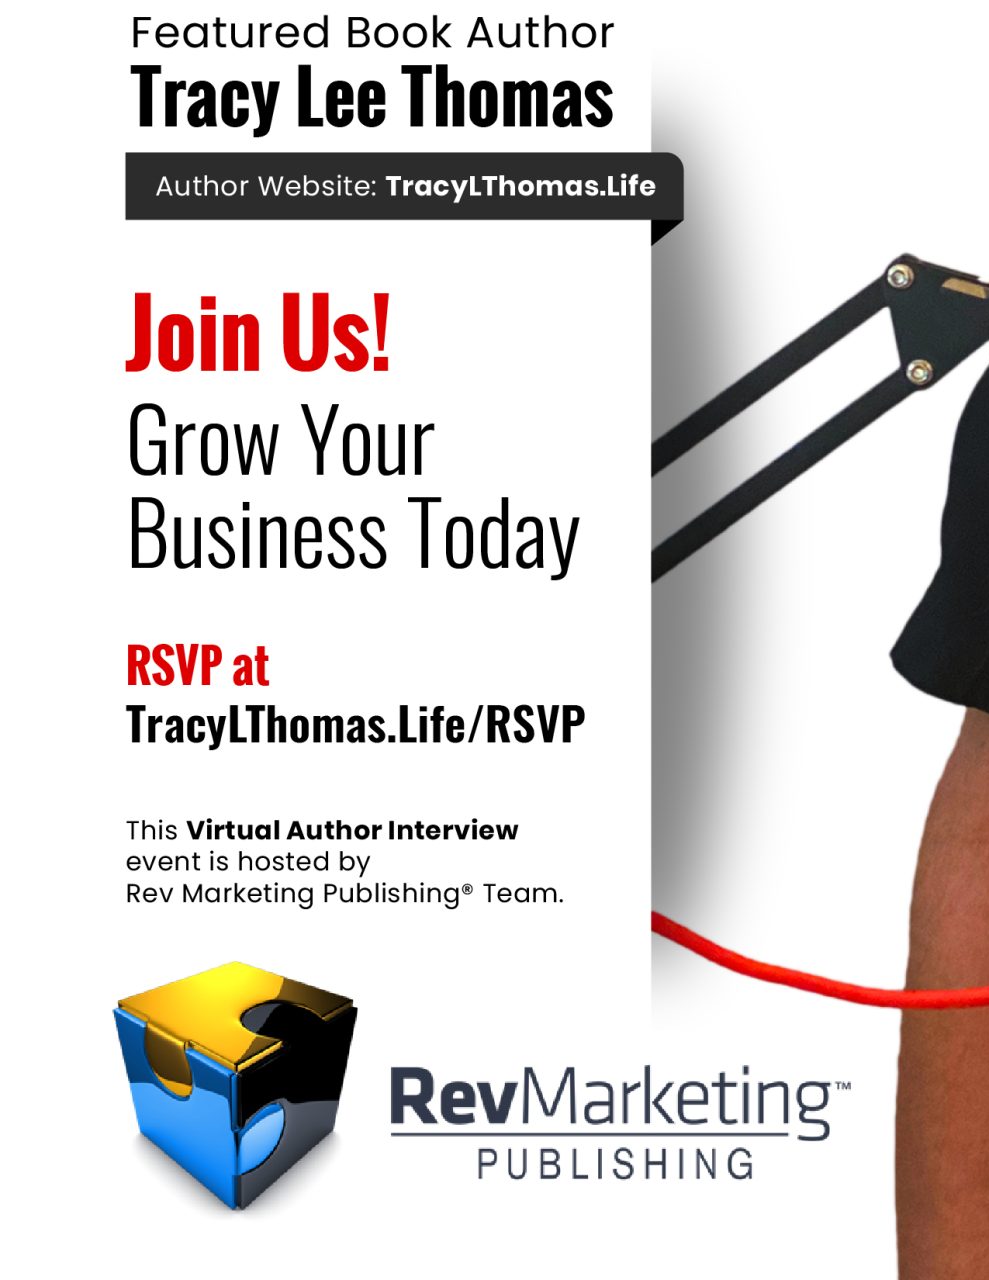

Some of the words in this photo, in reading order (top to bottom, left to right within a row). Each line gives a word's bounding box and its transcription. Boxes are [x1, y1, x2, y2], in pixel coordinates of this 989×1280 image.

[133, 15, 328, 48] Featured
[348, 15, 451, 48] Book
[467, 15, 614, 48] Author
[131, 65, 280, 137] Tracy
[298, 65, 385, 127] Lee
[401, 64, 613, 127] Thomas
[156, 175, 249, 196] Author
[258, 175, 375, 196] Website:
[386, 173, 655, 203] TracyLThomas.Life
[125, 293, 259, 372] Join
[283, 293, 389, 372] Us!
[130, 403, 279, 476] Grow
[301, 404, 434, 476] Your
[132, 497, 386, 569] Business
[408, 497, 579, 580] Today
[128, 644, 222, 686] RSVP
[233, 646, 269, 686] at
[126, 705, 585, 750] TracyLThomas.Life/RSVP
[126, 820, 177, 840] This
[187, 818, 279, 840] Virtual
[287, 820, 382, 840] Author
[389, 818, 518, 840] Interview
[127, 852, 200, 871] event
[210, 851, 228, 871] is
[239, 851, 328, 871] hosted
[340, 851, 370, 877] by
[128, 884, 173, 903] Rev
[183, 882, 313, 909] Marketing
[483, 884, 563, 902] Team.
[479, 1148, 752, 1179] PUBLISHING
